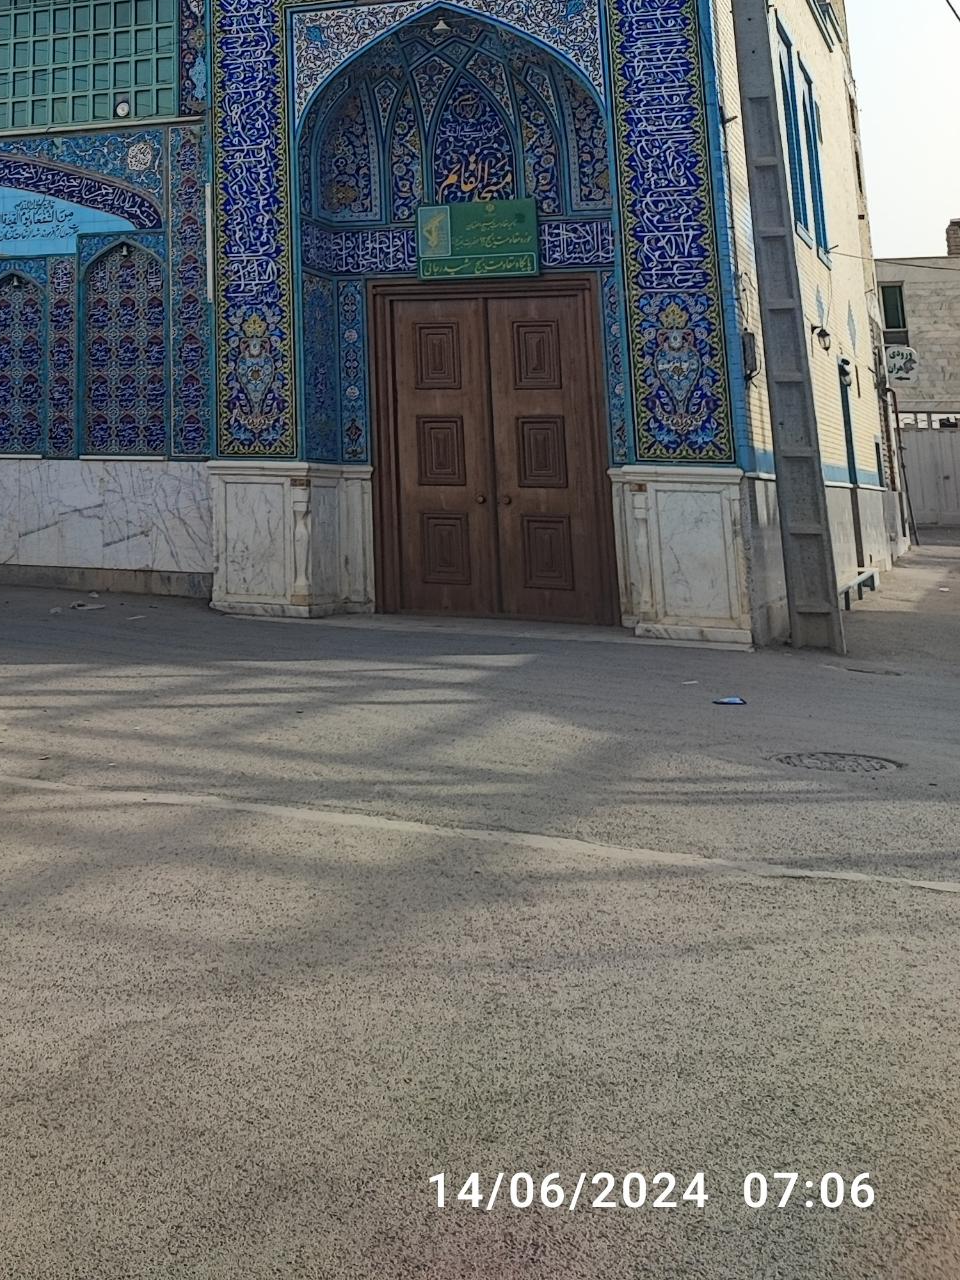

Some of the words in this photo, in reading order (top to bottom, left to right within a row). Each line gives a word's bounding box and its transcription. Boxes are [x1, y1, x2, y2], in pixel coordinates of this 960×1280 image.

[444, 257, 473, 275] شهید
[486, 256, 516, 271] مقاومت
[889, 350, 913, 360] ورودی
